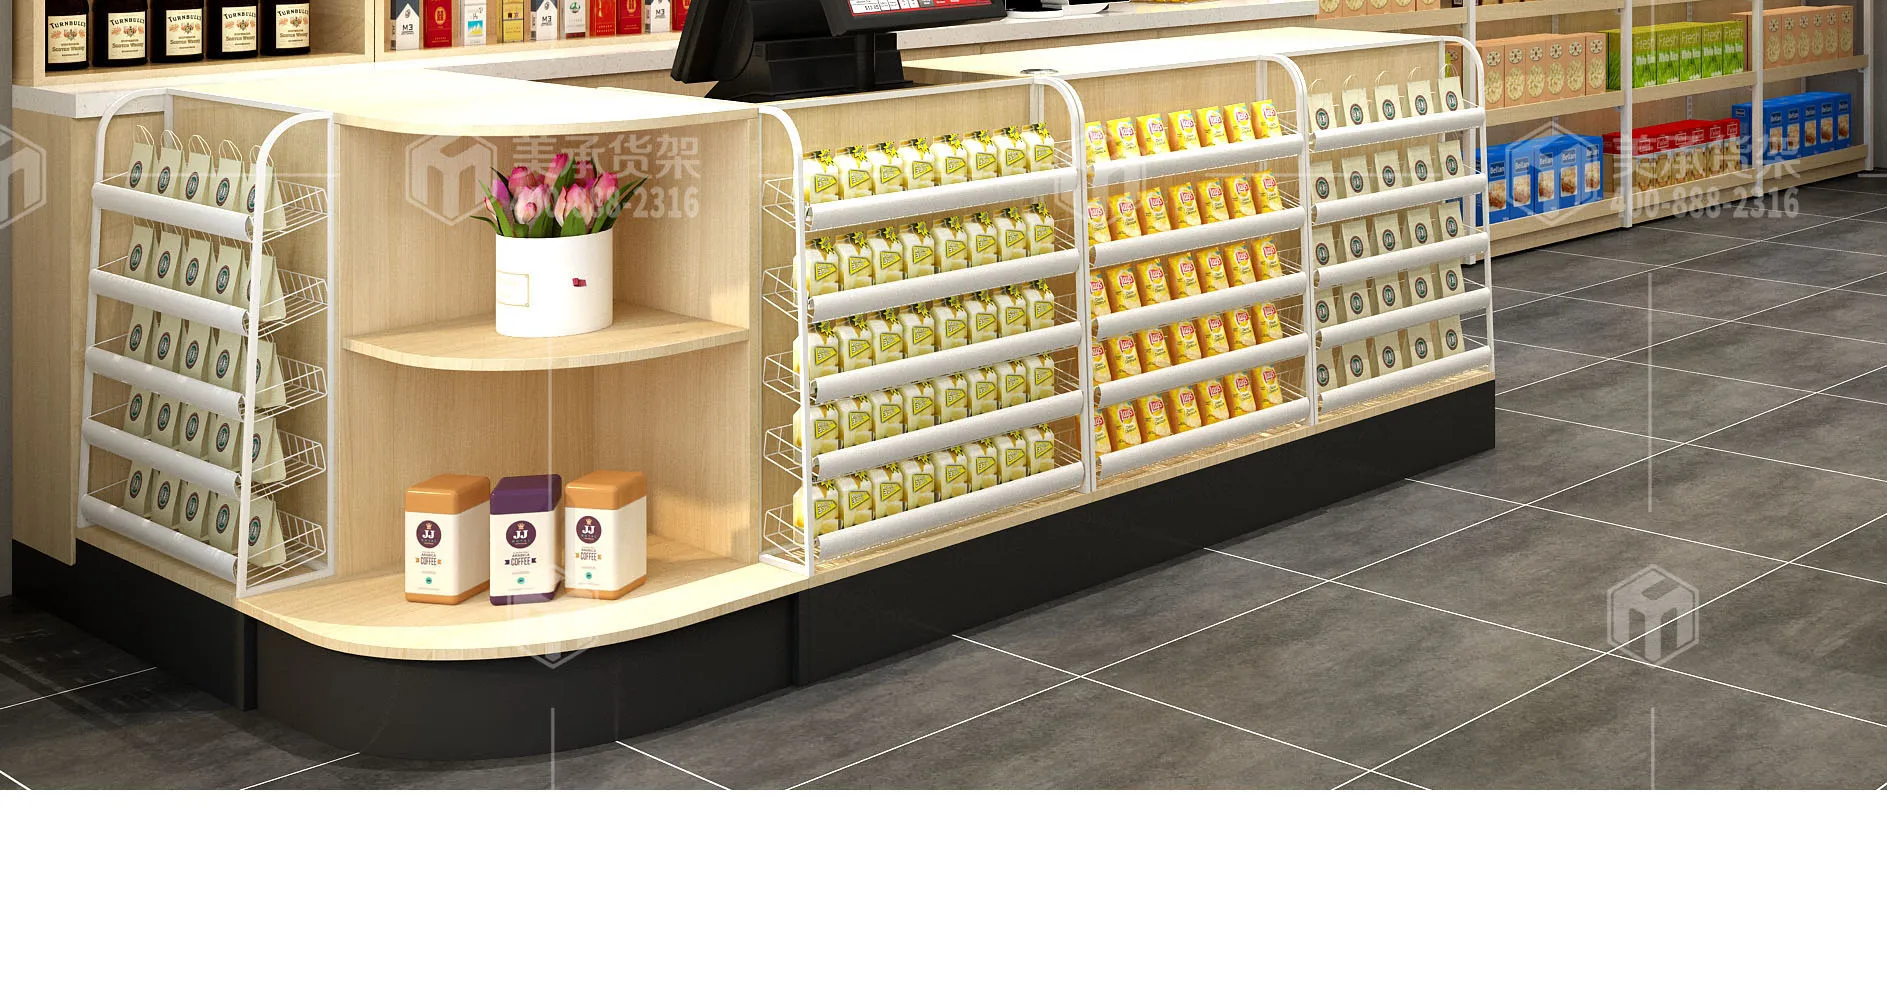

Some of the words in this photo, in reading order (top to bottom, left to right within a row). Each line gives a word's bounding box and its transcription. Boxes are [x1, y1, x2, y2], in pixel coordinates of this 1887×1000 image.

[655, 8, 666, 16] M3
[402, 24, 414, 32] M3
[582, 525, 595, 534] JJ
[422, 530, 435, 539] JJ
[513, 530, 529, 539] JJ
[580, 551, 597, 561] COFFEE
[420, 556, 437, 566] COFFEE
[510, 556, 530, 566] COFFEE
